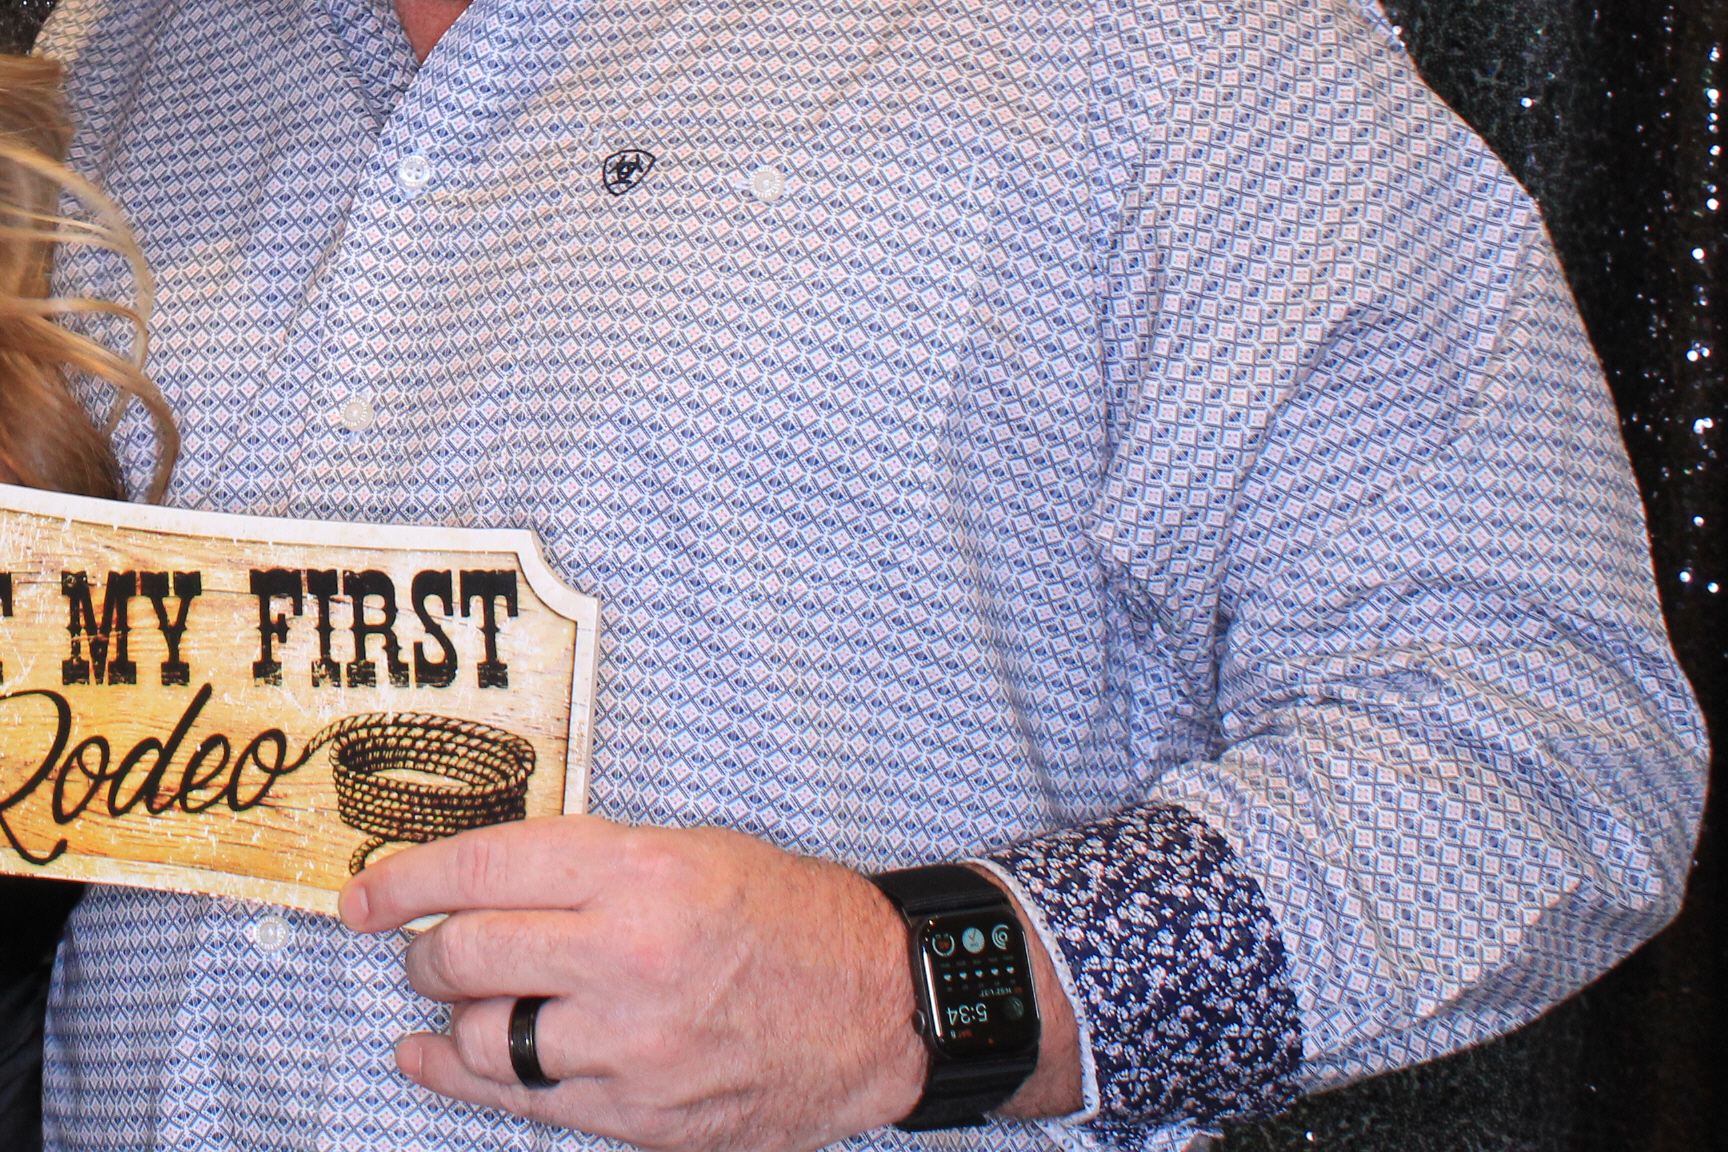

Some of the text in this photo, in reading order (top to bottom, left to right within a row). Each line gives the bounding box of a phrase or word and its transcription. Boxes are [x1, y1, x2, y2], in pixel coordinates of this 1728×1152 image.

[60, 570, 202, 686] MY
[249, 569, 519, 689] FIRST
[946, 1002, 988, 1026] 5:34
